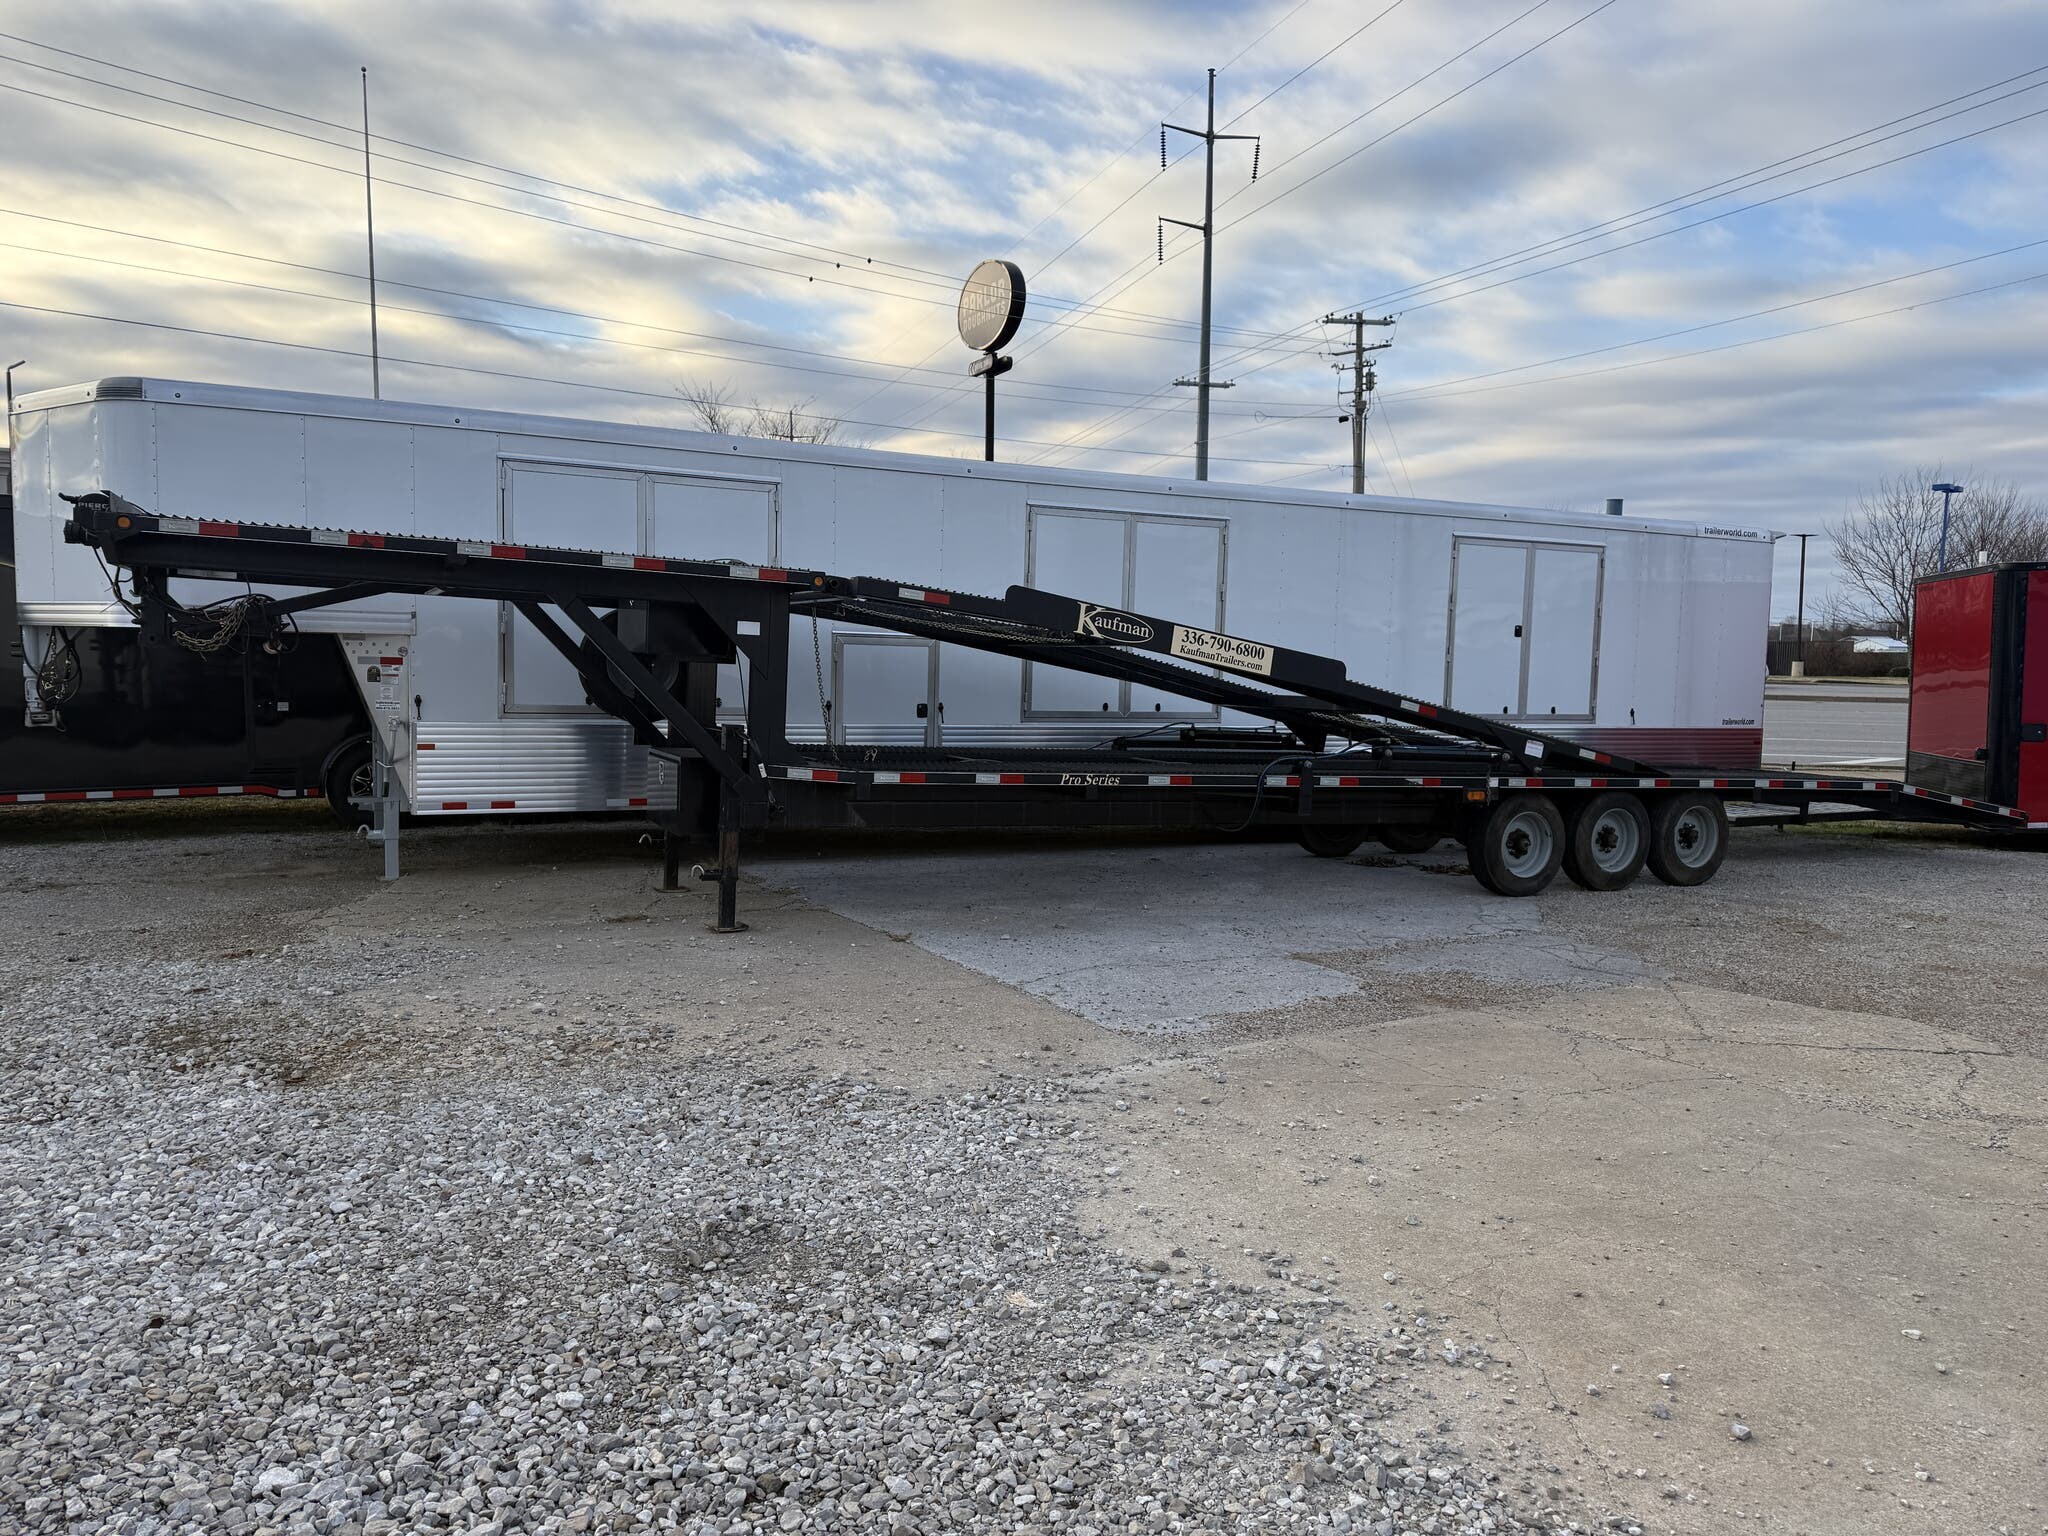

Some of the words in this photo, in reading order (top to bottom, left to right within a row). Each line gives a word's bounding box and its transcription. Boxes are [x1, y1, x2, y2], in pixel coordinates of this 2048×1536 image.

[962, 278, 1005, 318] PARLOR
[963, 301, 1006, 332] DOUGHNUTS
[1704, 526, 1758, 539] trailerworld.com
[1073, 601, 1150, 639] Kaufman
[1179, 645, 1263, 671] KaufmanTrailers.com
[1181, 629, 1265, 660] 336-790-6800
[1721, 717, 1755, 726] trailerworld.com
[1060, 773, 1082, 785] Pro
[1085, 773, 1121, 786] Series
